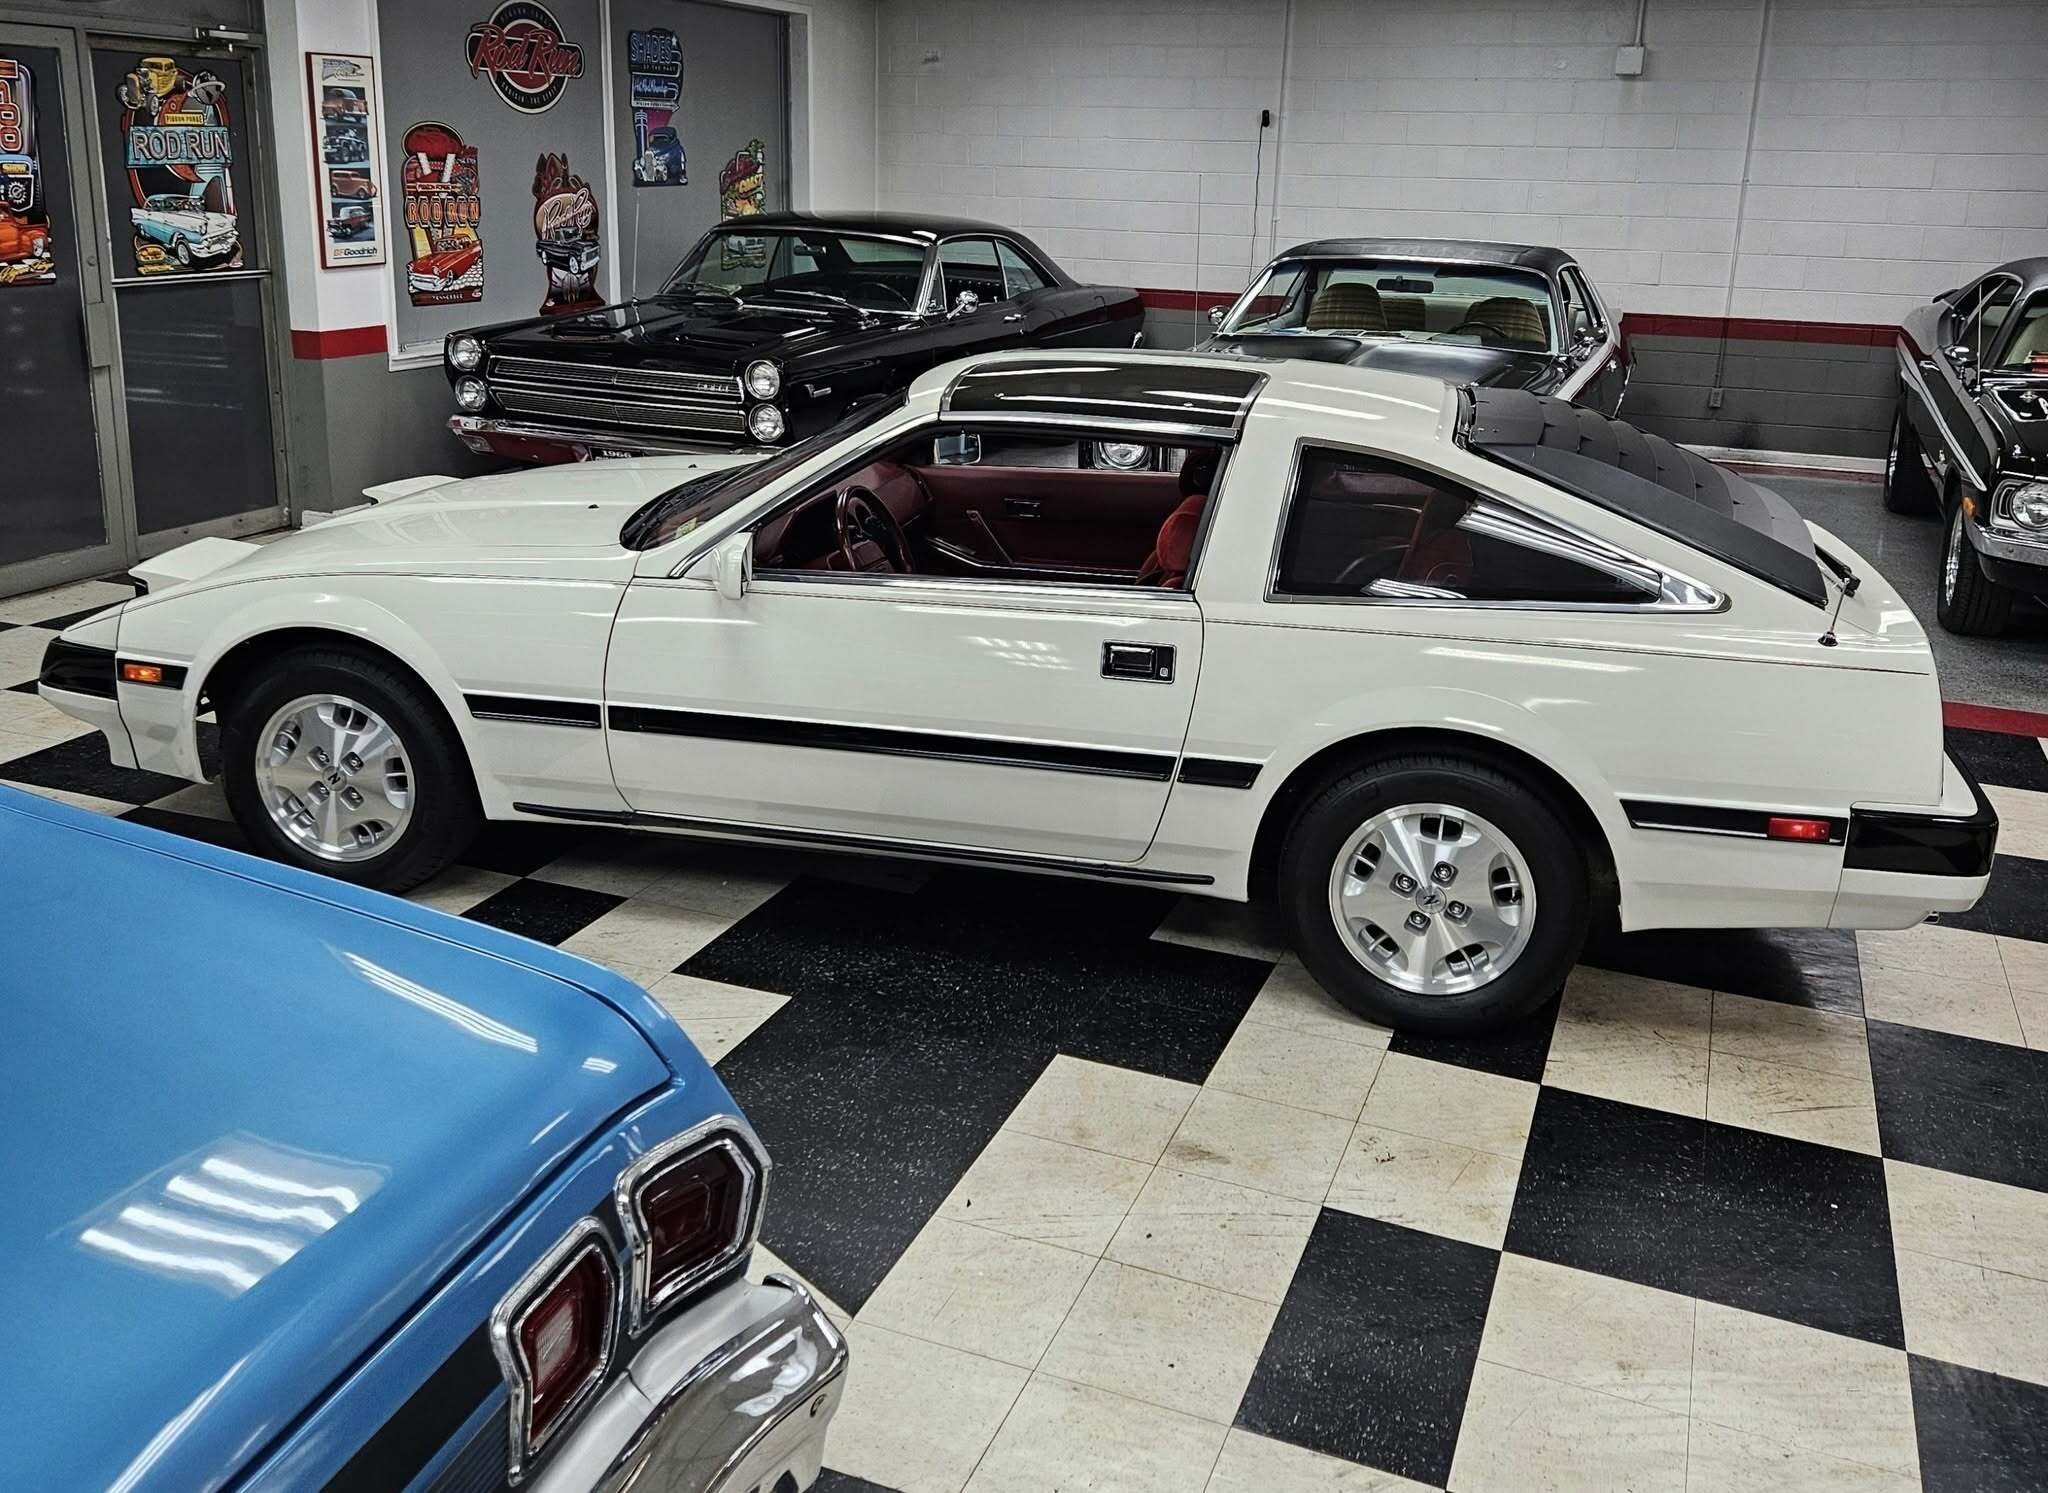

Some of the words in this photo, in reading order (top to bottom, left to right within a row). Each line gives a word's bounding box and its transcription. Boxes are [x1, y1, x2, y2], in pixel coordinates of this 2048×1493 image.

[631, 32, 672, 64] SHADES
[132, 131, 181, 159] ROD
[185, 131, 230, 159] RUN
[408, 202, 442, 222] ROD
[447, 202, 479, 222] RUN
[334, 247, 377, 256] BFGoodrich
[602, 450, 632, 458] 1966
